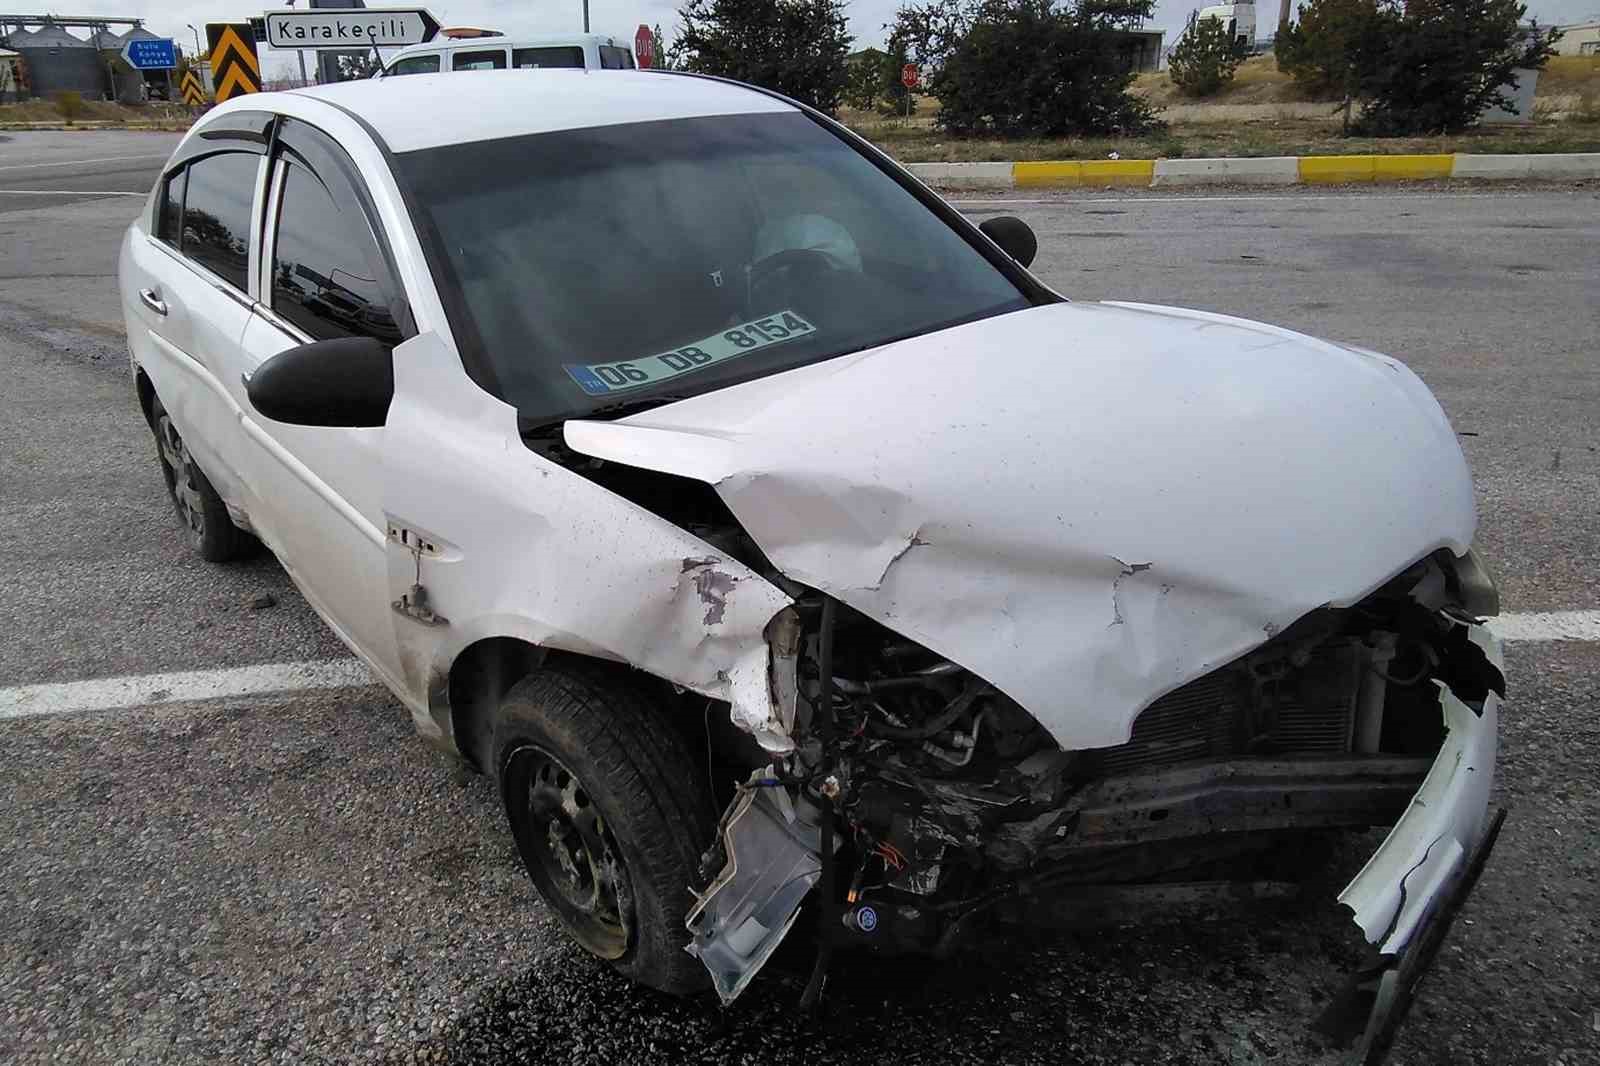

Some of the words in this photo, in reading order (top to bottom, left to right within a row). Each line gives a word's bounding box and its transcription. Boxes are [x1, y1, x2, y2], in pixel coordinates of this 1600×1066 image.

[278, 20, 405, 40] Karakeçili
[637, 39, 653, 56] DUR
[904, 70, 916, 80] DUR
[594, 363, 649, 386] 06
[657, 347, 713, 371] DB
[724, 313, 810, 348] 8154
